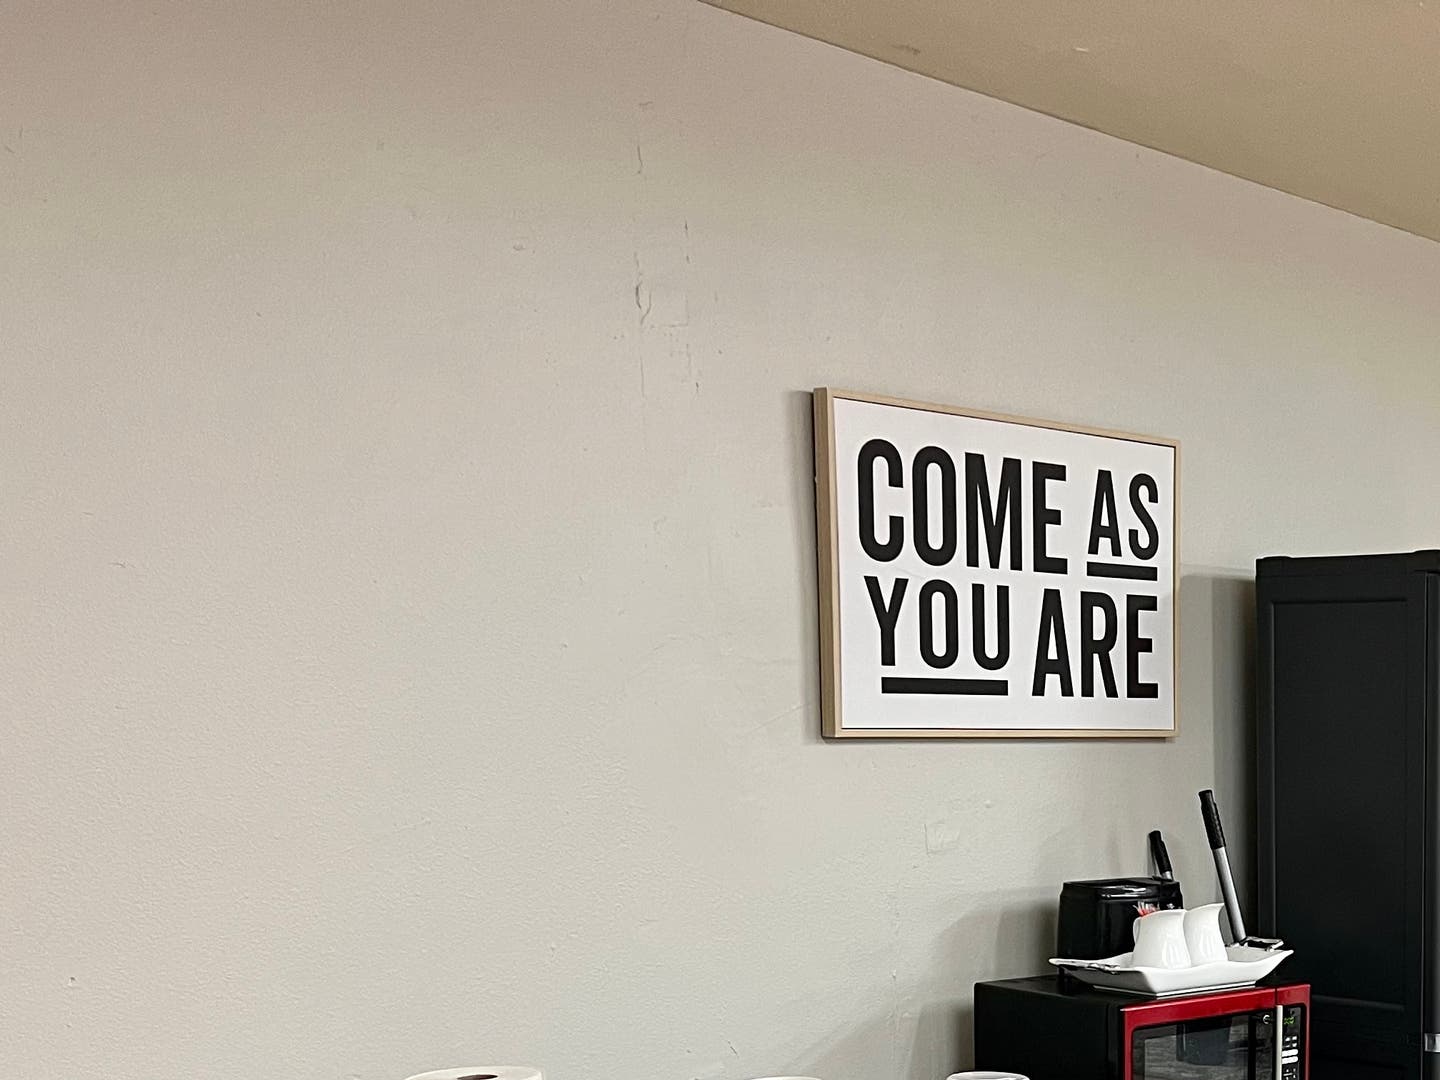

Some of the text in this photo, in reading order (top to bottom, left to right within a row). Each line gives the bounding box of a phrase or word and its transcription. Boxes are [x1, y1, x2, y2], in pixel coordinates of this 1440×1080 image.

[857, 438, 1159, 575] COME AS
[863, 575, 1159, 698] YOU ARE
